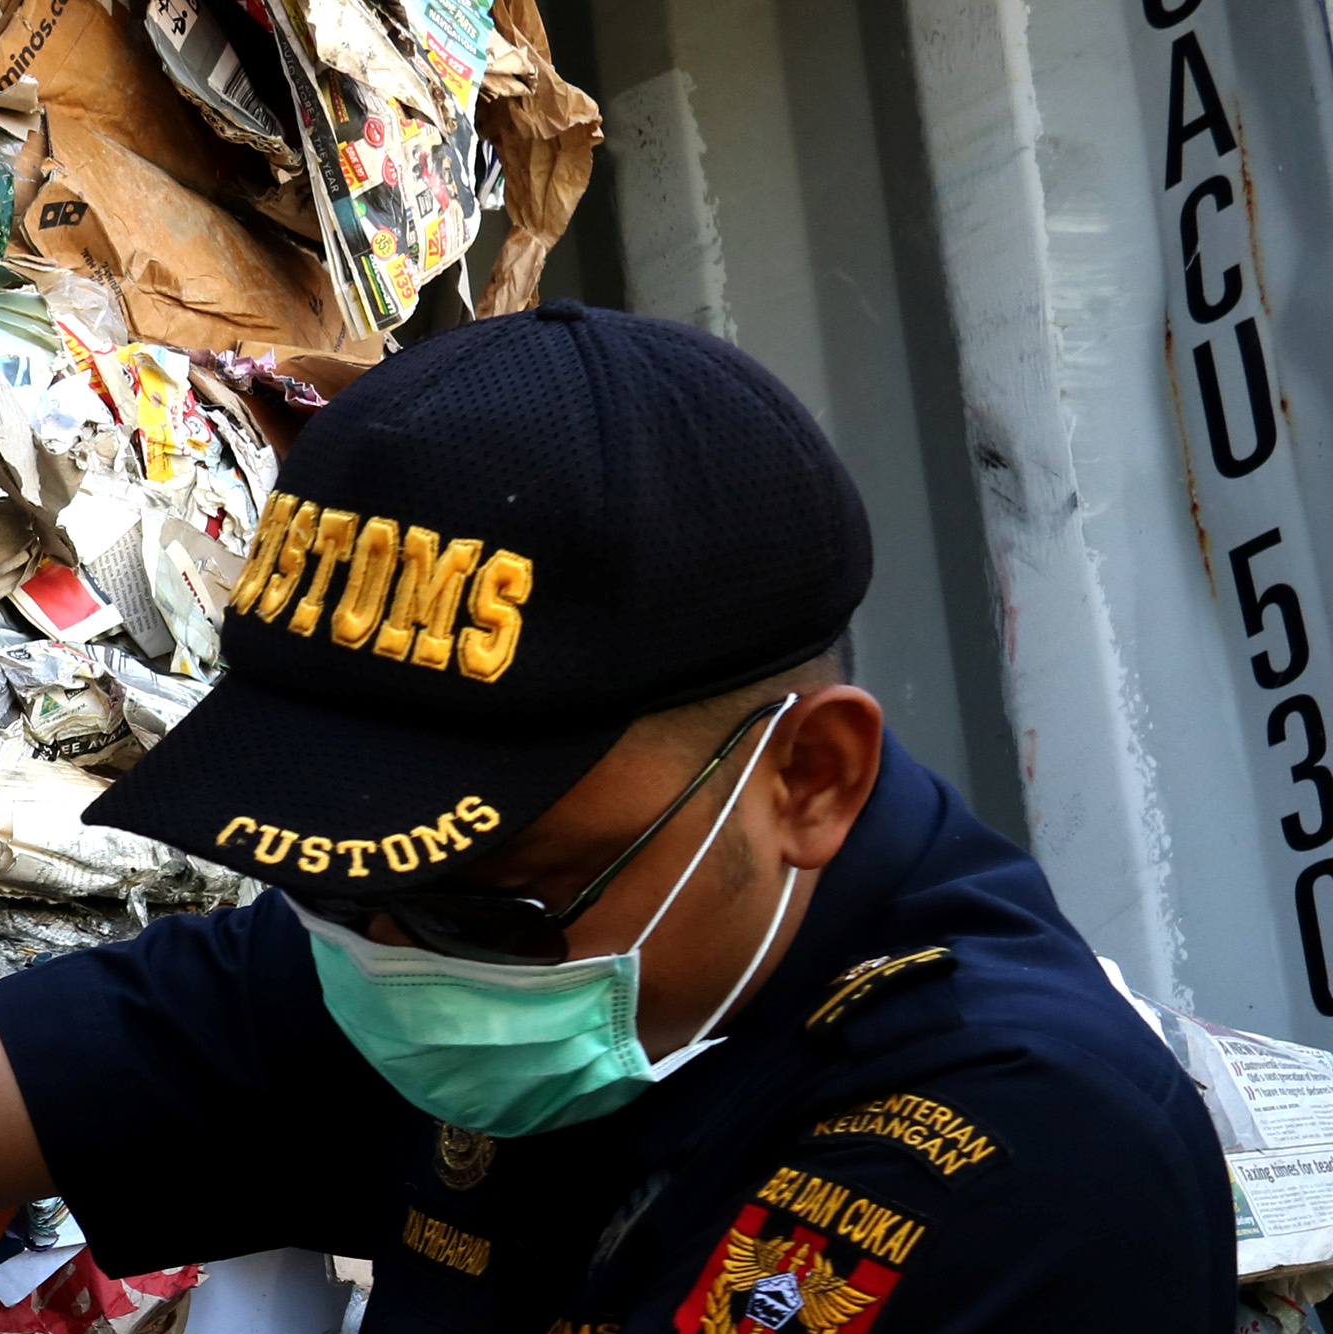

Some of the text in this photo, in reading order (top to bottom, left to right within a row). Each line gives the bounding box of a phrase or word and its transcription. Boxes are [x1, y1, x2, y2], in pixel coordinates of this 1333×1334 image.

[428, 9, 478, 55] NAVIGATION
[282, 41, 297, 76] AUTO
[314, 138, 328, 163] THE
[321, 160, 340, 194] YEAR
[1141, 0, 1278, 479] ACU
[230, 490, 532, 683] USTOMS
[215, 796, 500, 878] CUSTOMS
[812, 1113, 970, 1176] KEUANGAN
[1237, 1157, 1316, 1184] Taxing times for
[757, 1166, 928, 1265] BEA DAN CUKAI
